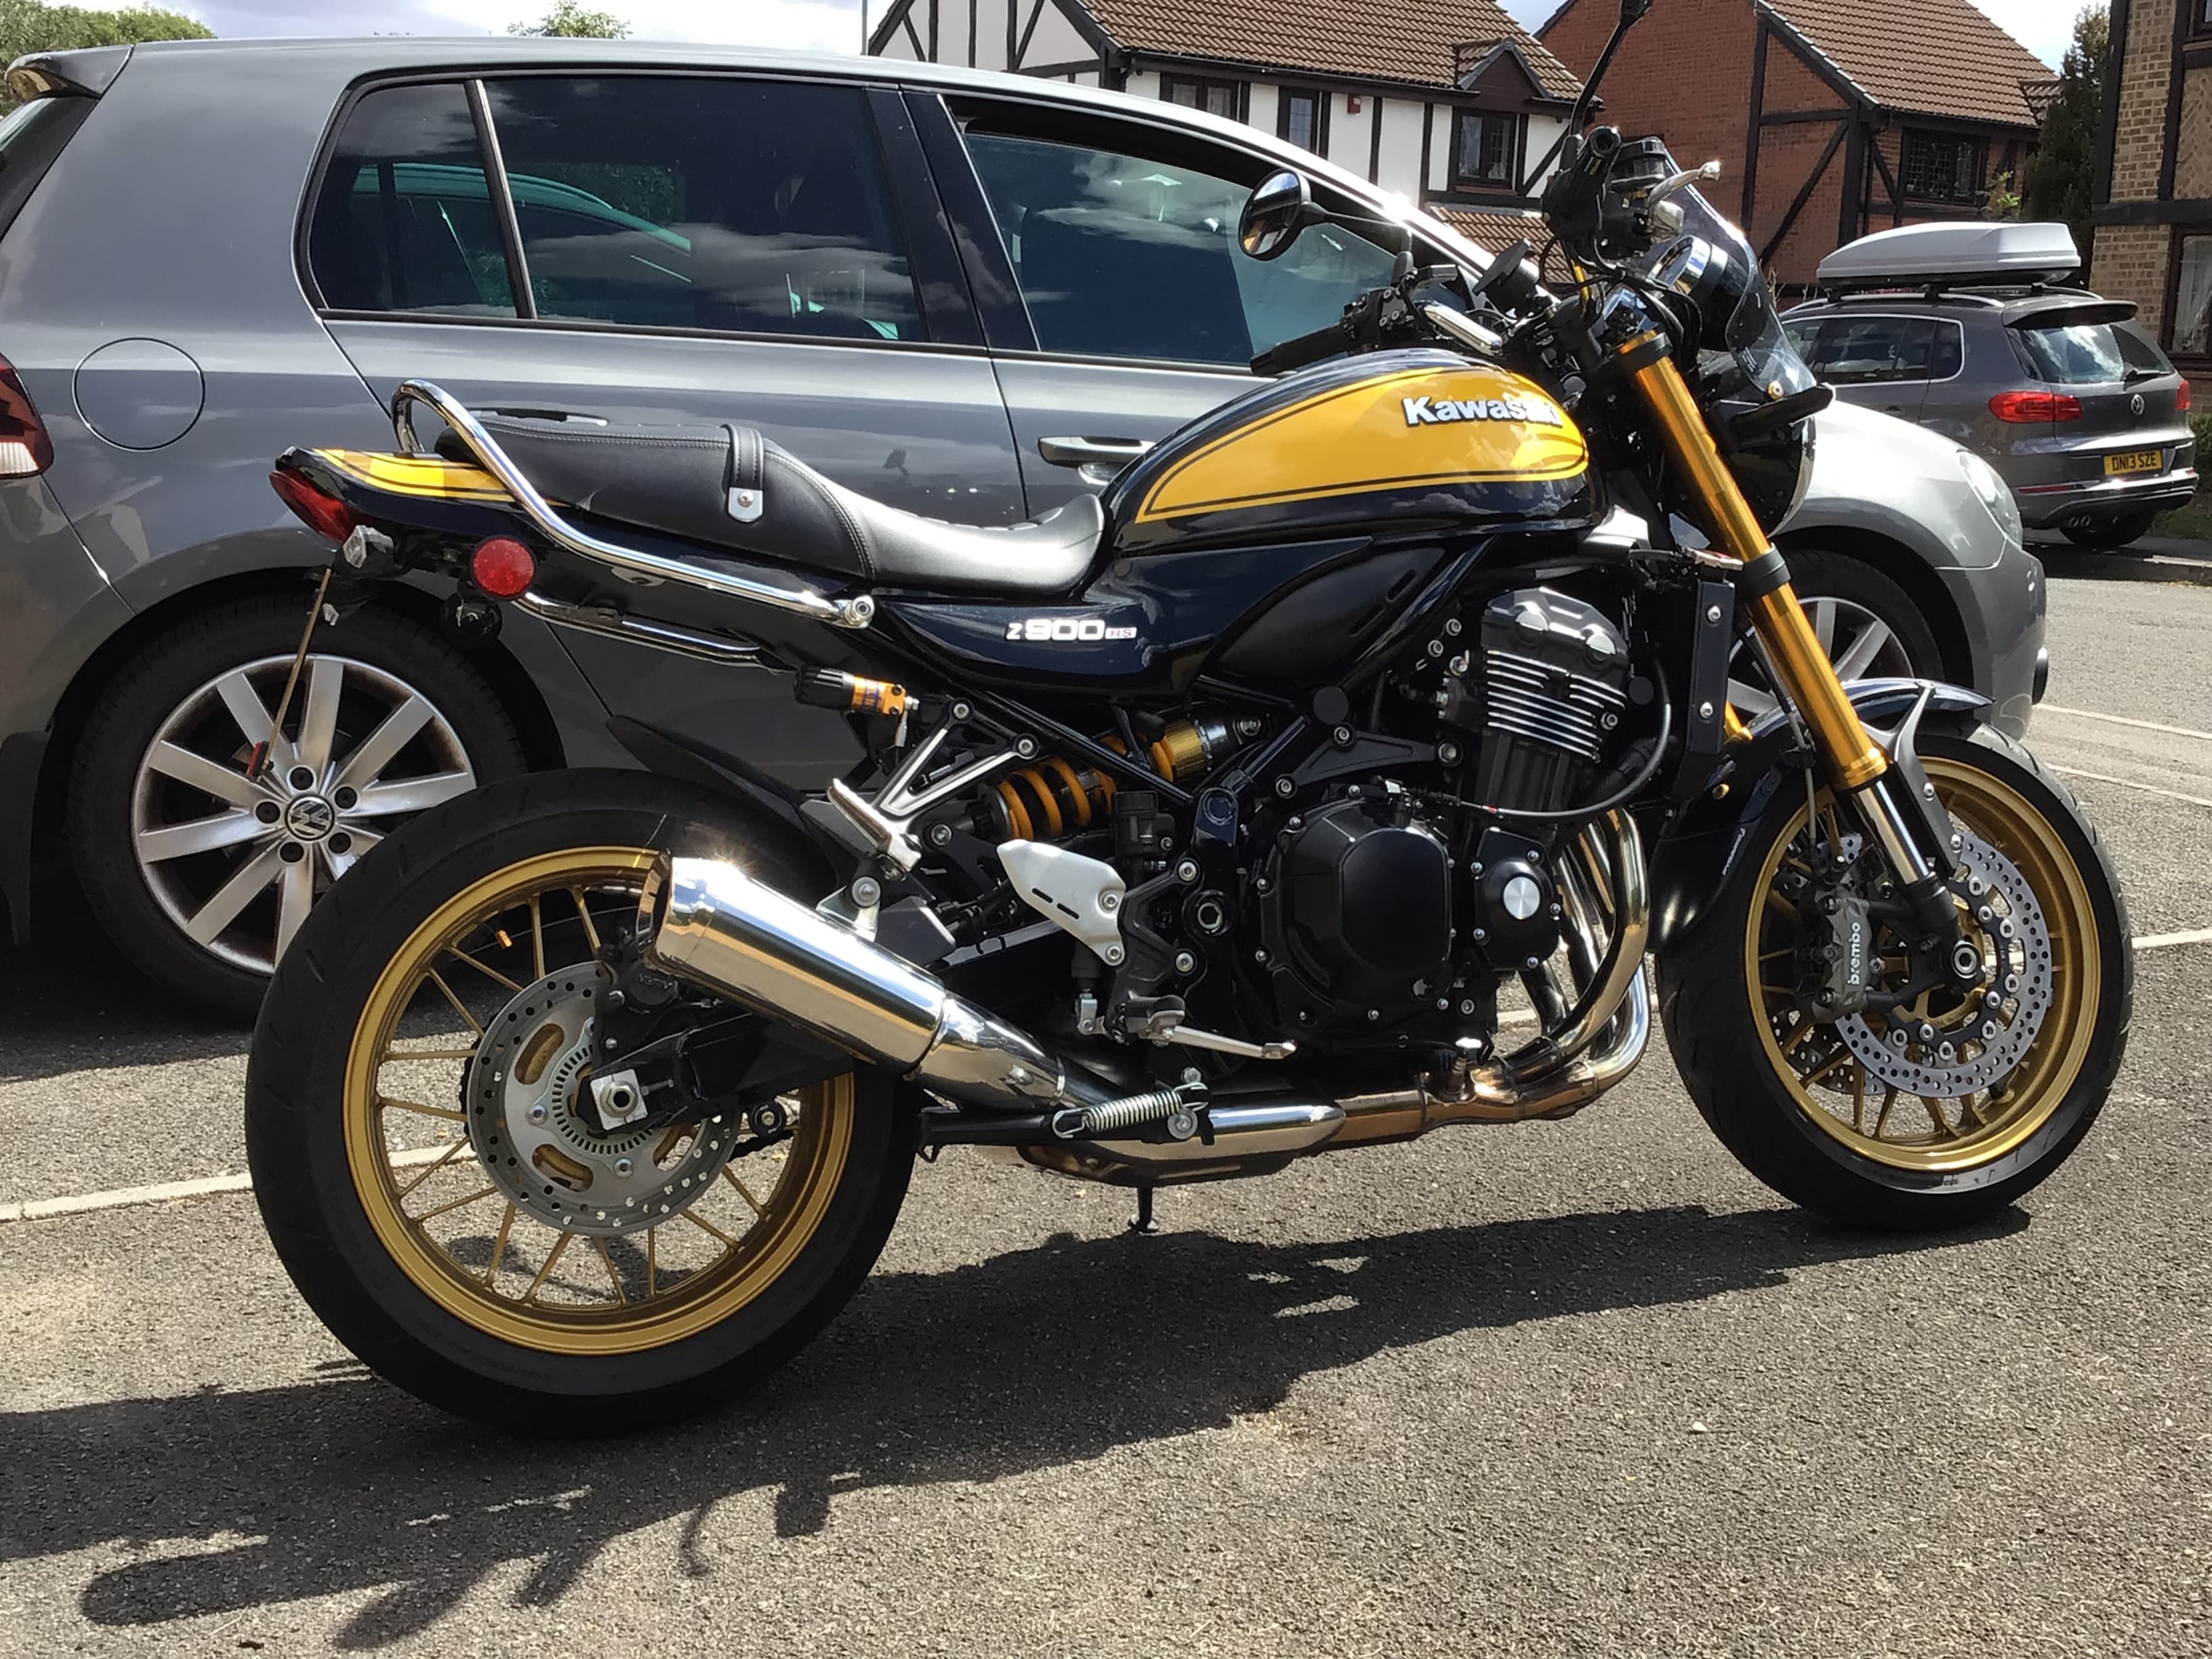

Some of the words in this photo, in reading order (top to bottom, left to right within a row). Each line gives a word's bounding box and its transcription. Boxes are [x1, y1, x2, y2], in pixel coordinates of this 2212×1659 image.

[1401, 396, 1563, 428] Kawasi
[2112, 455, 2136, 471] DN13
[2137, 452, 2156, 468] SZE
[1847, 922, 1861, 985] brembo
